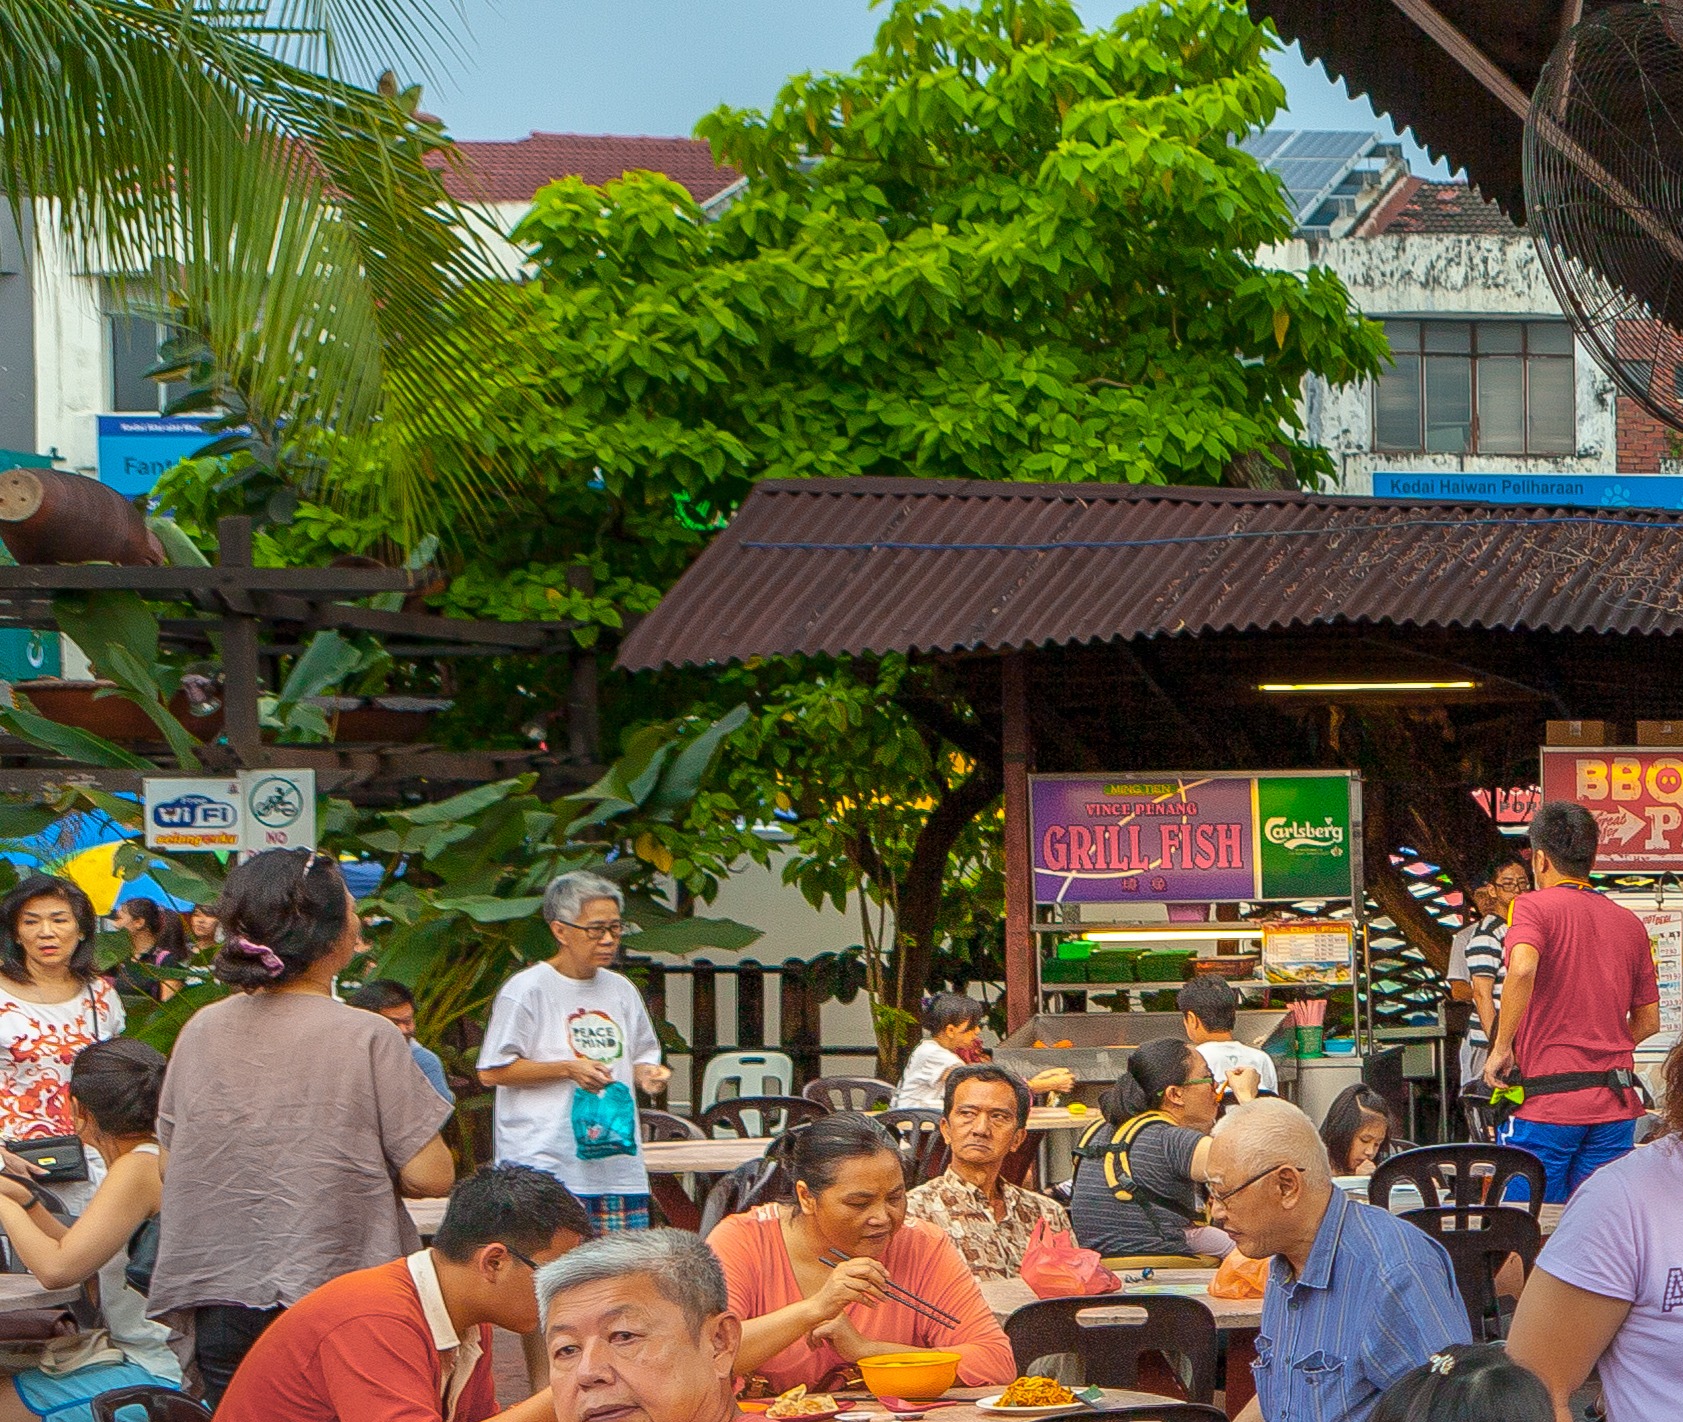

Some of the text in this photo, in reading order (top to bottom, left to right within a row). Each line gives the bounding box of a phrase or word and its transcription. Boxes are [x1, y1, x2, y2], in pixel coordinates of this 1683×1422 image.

[1390, 478, 1584, 496] Kedai Haiwan Peliharaan
[1085, 801, 1198, 817] VINCE PENANG
[265, 831, 288, 845] NO
[1264, 816, 1343, 847] Carlsberg
[1043, 822, 1244, 871] GRILL FISH
[571, 1026, 616, 1038] PEACE
